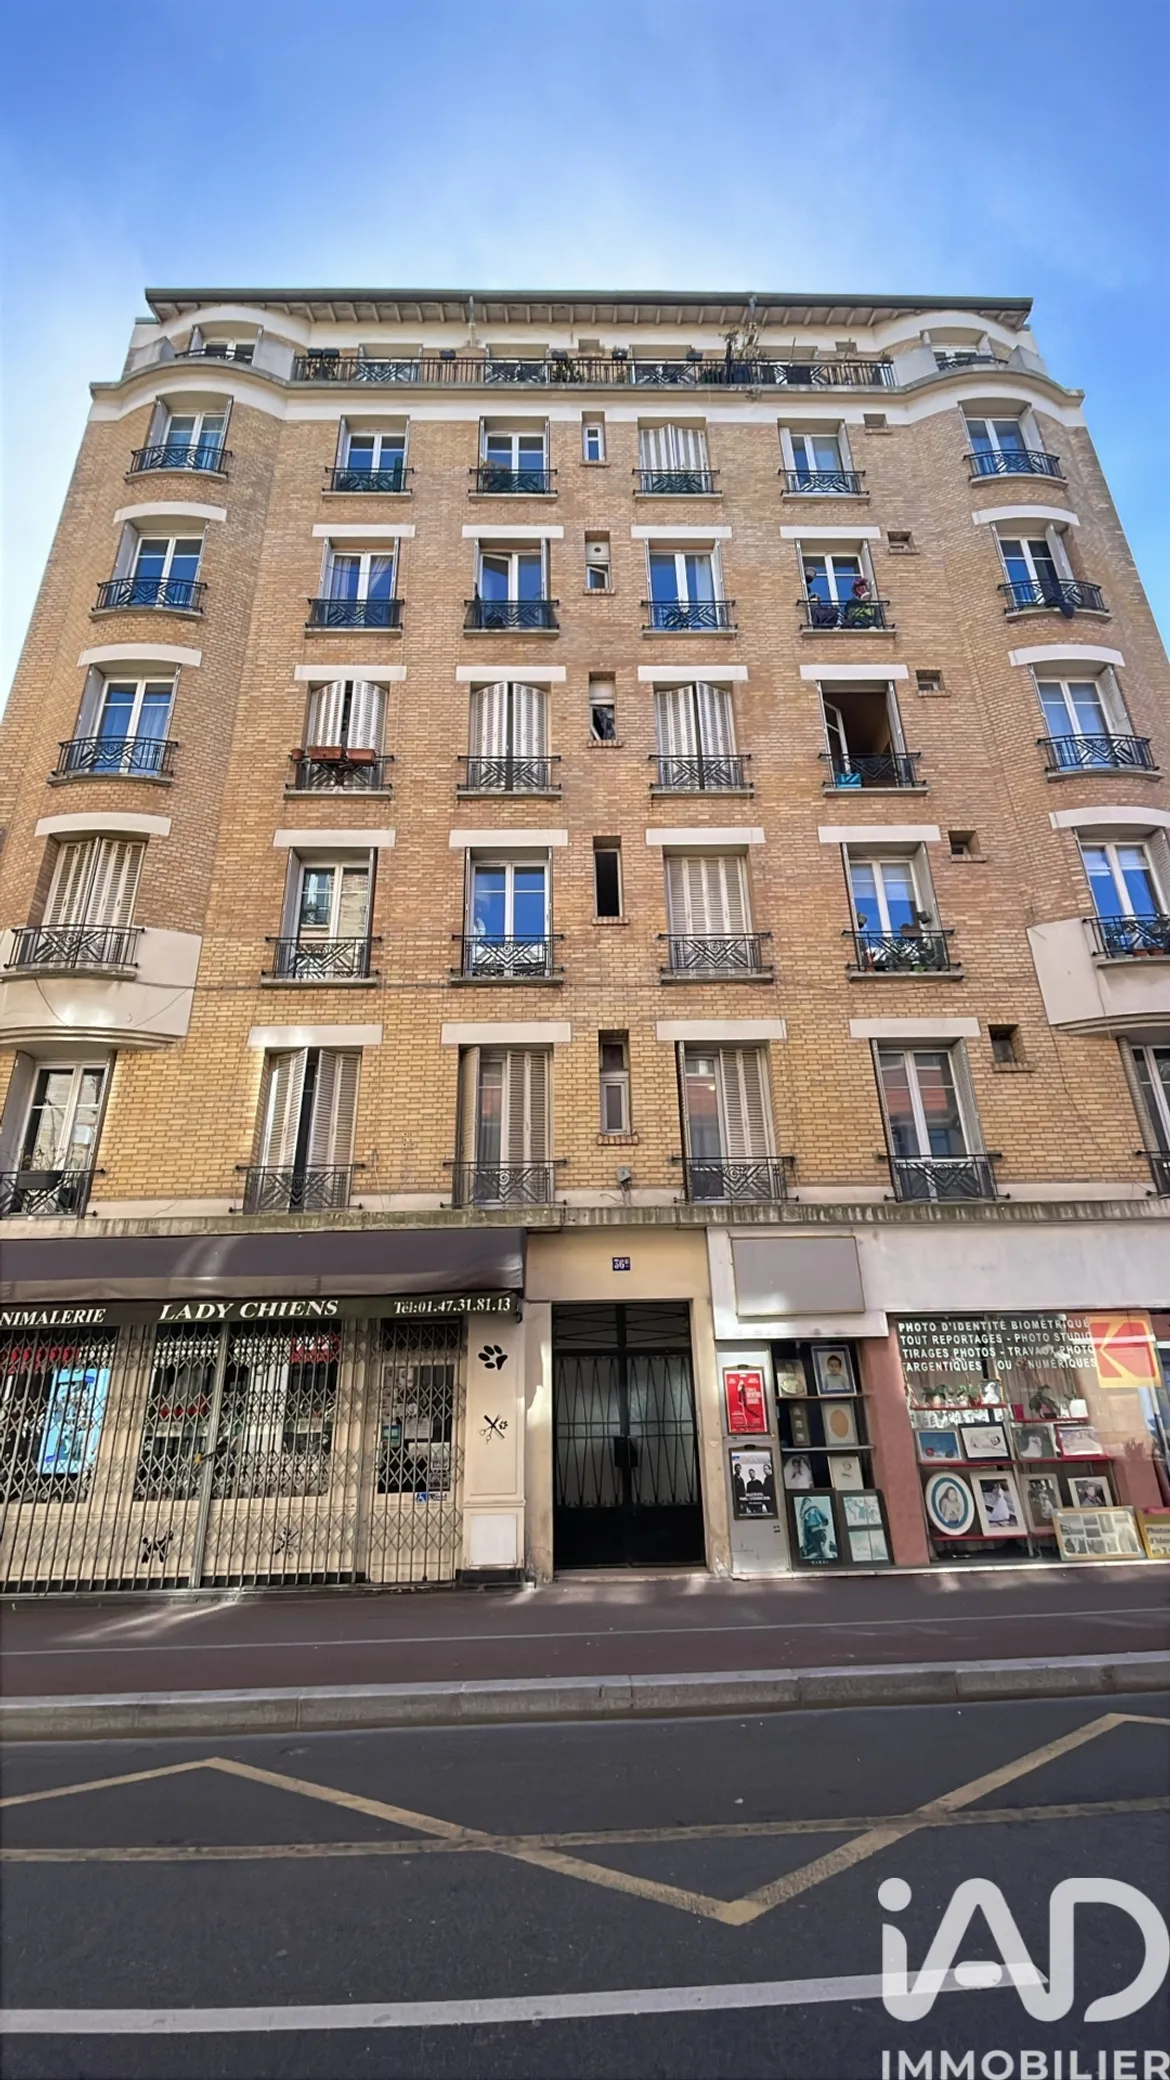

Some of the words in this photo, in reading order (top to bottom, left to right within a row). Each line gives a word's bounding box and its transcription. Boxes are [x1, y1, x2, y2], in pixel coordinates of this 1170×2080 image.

[0, 1308, 106, 1326] NIMALERIE
[158, 1303, 235, 1321] LADY
[239, 1300, 339, 1319] CHIENS
[898, 1322, 937, 1333] PHOTO
[900, 1335, 928, 1346] TOUT
[932, 1333, 1003, 1345] REPORTAGES
[1014, 1332, 1050, 1343] PHOTO
[1053, 1331, 1092, 1342] STUDIO
[902, 1348, 949, 1359] TIRAGES
[953, 1346, 997, 1359] PHOTOS
[1059, 1344, 1095, 1355] PHOTO
[906, 1360, 982, 1373] ARGENTIQUES
[997, 1360, 1012, 1370] OU
